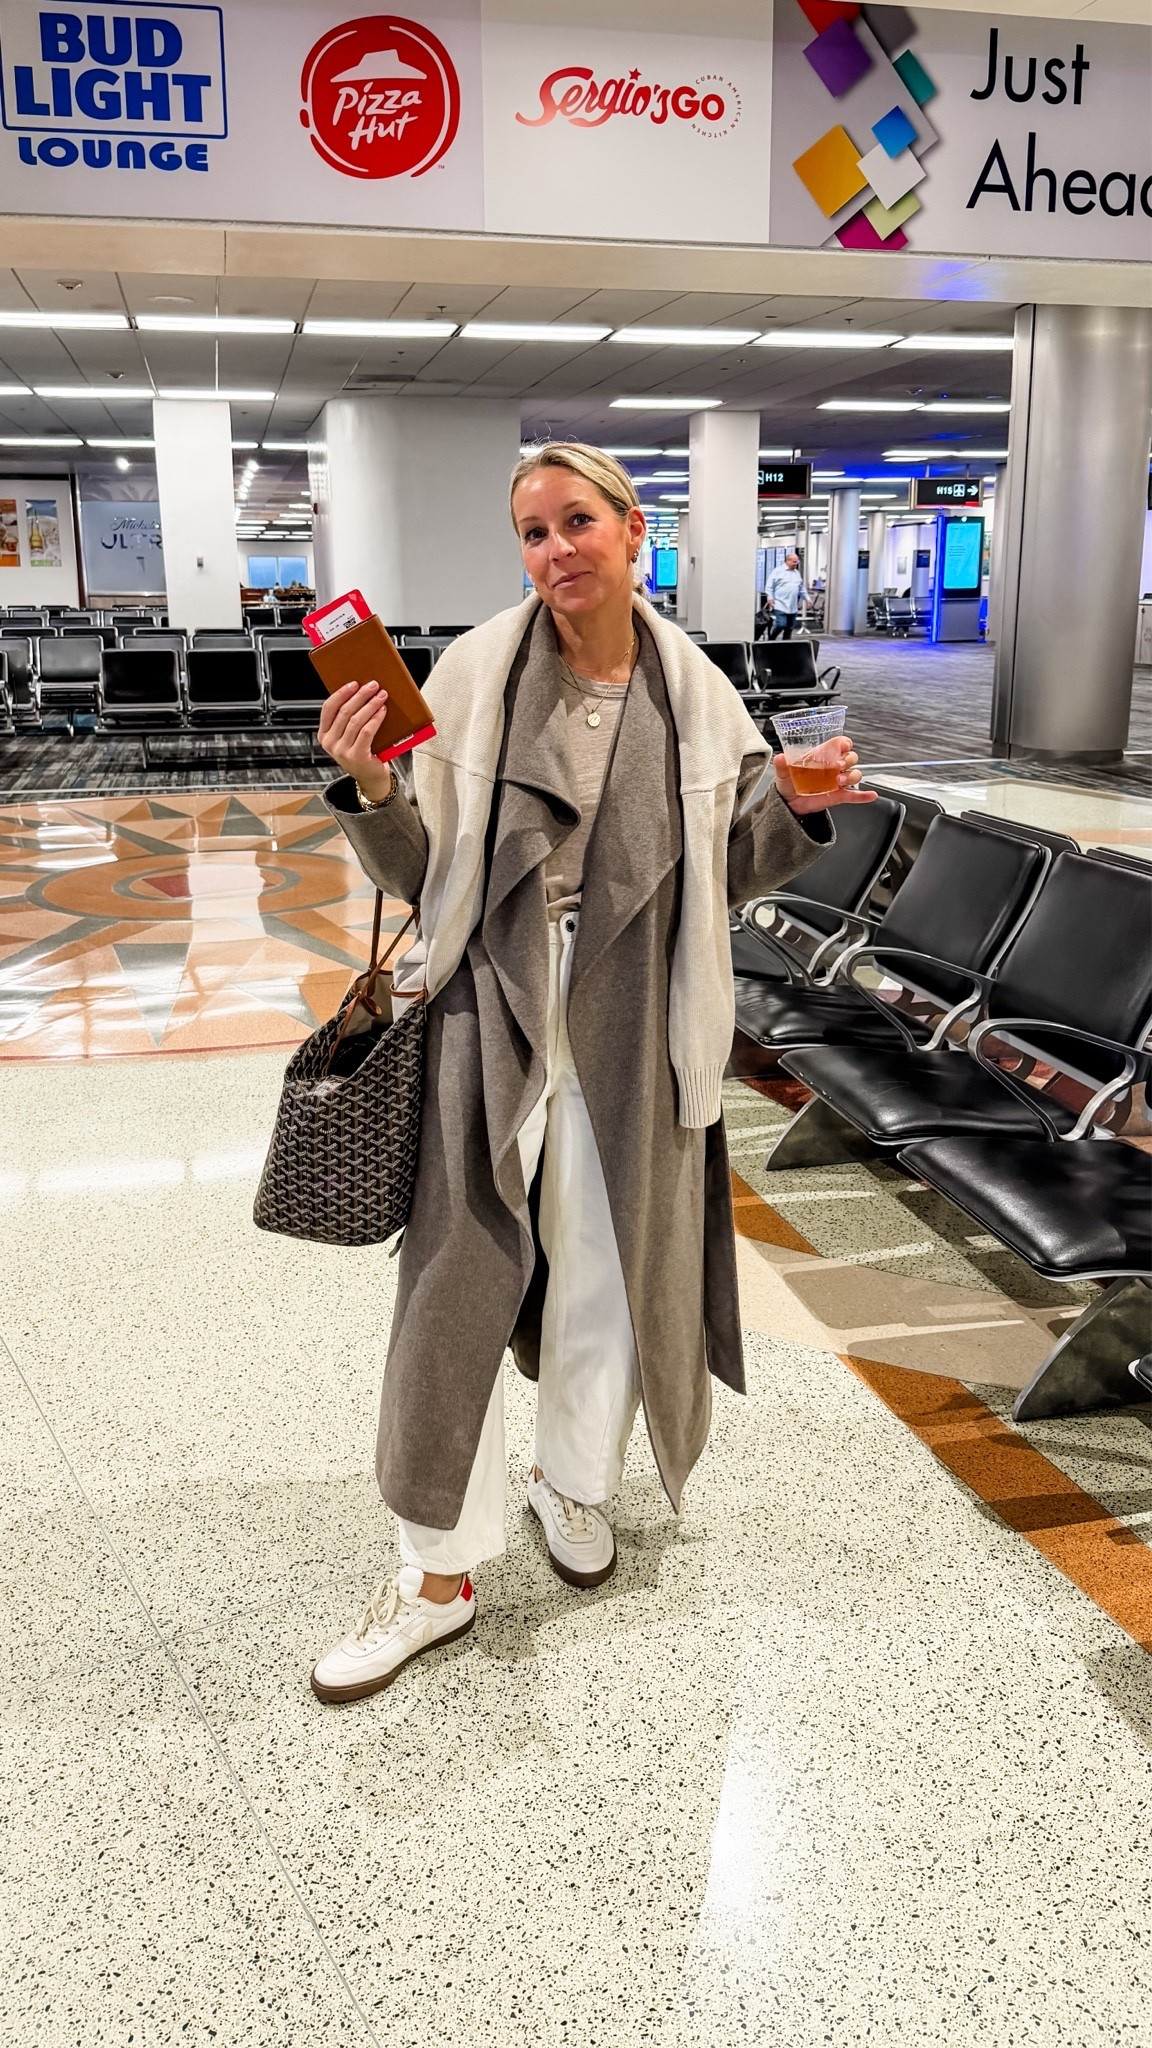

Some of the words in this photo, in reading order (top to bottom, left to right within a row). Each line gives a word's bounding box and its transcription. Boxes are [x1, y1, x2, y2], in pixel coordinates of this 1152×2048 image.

[39, 12, 183, 67] BUD
[695, 74, 724, 85] CUBAN
[969, 27, 1090, 105] Just
[14, 66, 211, 122] LIGHT
[332, 81, 423, 126] Pizza
[727, 82, 742, 129] AMERICAN
[347, 111, 419, 151] Hut
[691, 123, 727, 138] KITCHEN
[765, 472, 784, 482] H12
